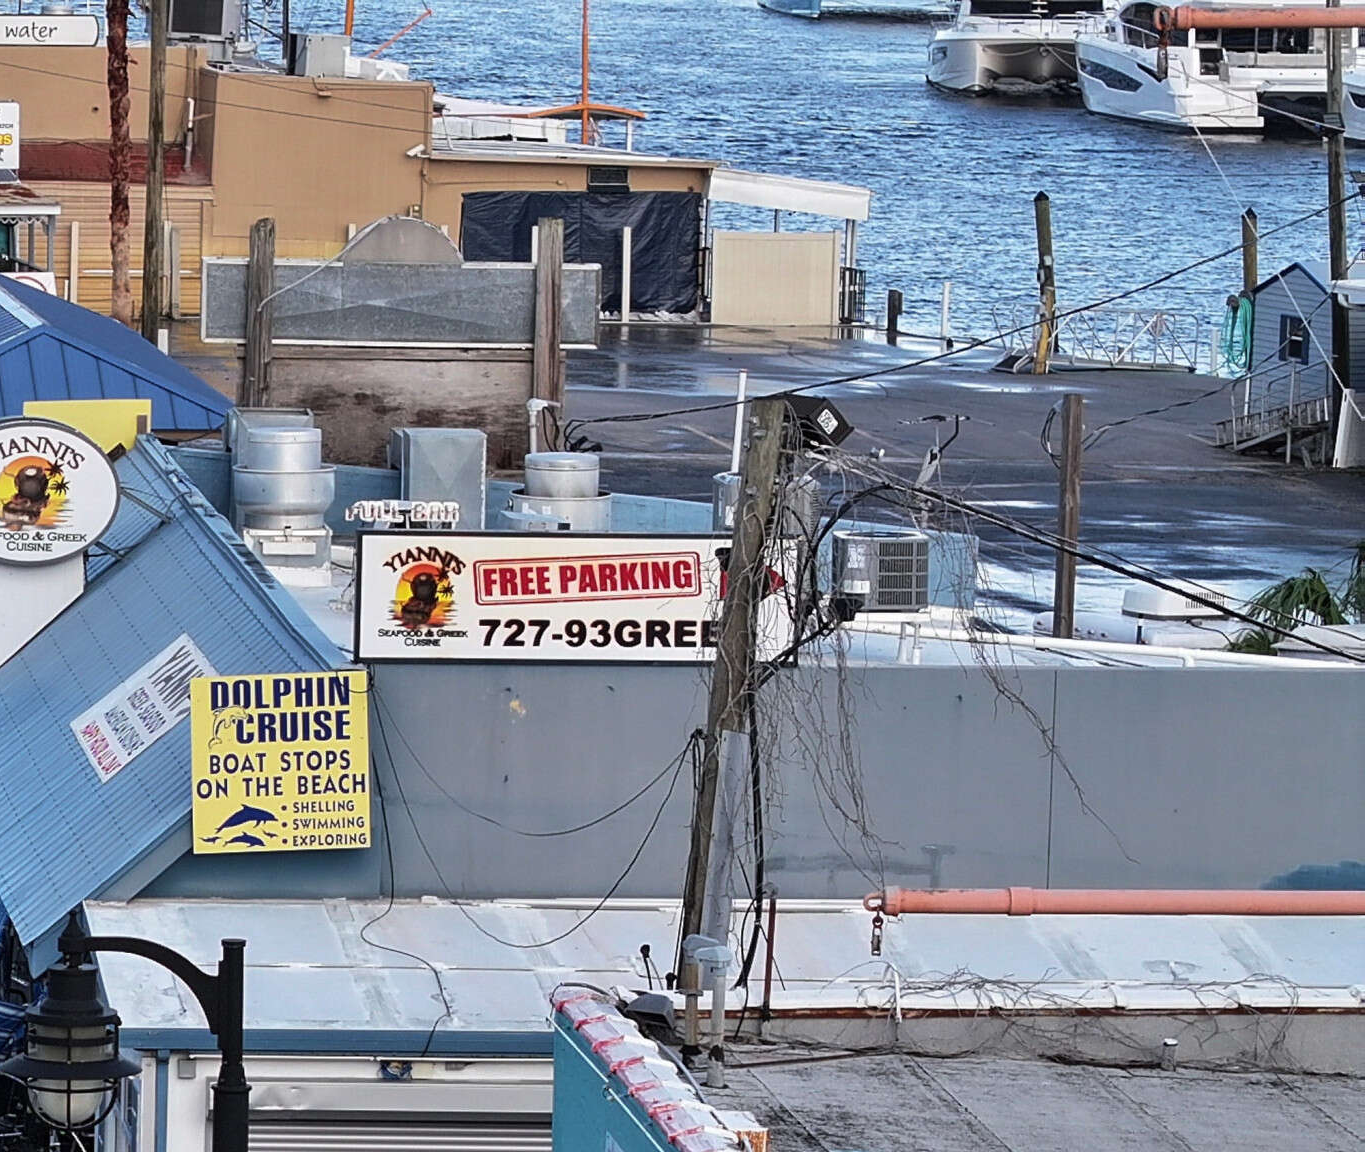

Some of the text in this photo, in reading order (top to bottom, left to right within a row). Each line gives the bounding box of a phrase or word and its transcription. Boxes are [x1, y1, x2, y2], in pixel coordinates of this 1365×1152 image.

[5, 23, 58, 40] water
[6, 540, 53, 552] CUISINE
[32, 531, 45, 542] &
[47, 531, 88, 543] GREEK
[382, 546, 467, 576] YIANNI'S
[482, 559, 694, 597] FREE PARKING
[478, 618, 719, 648] 727-93GREE
[210, 676, 350, 712] DOLPHIN
[235, 710, 351, 745] CRUISE
[209, 749, 351, 775] BOAT STOPS
[196, 773, 367, 800] ON THE BEACH
[292, 799, 355, 814] SHELLING
[292, 816, 366, 831] SWIMMING
[292, 832, 367, 847] EXPLORING
